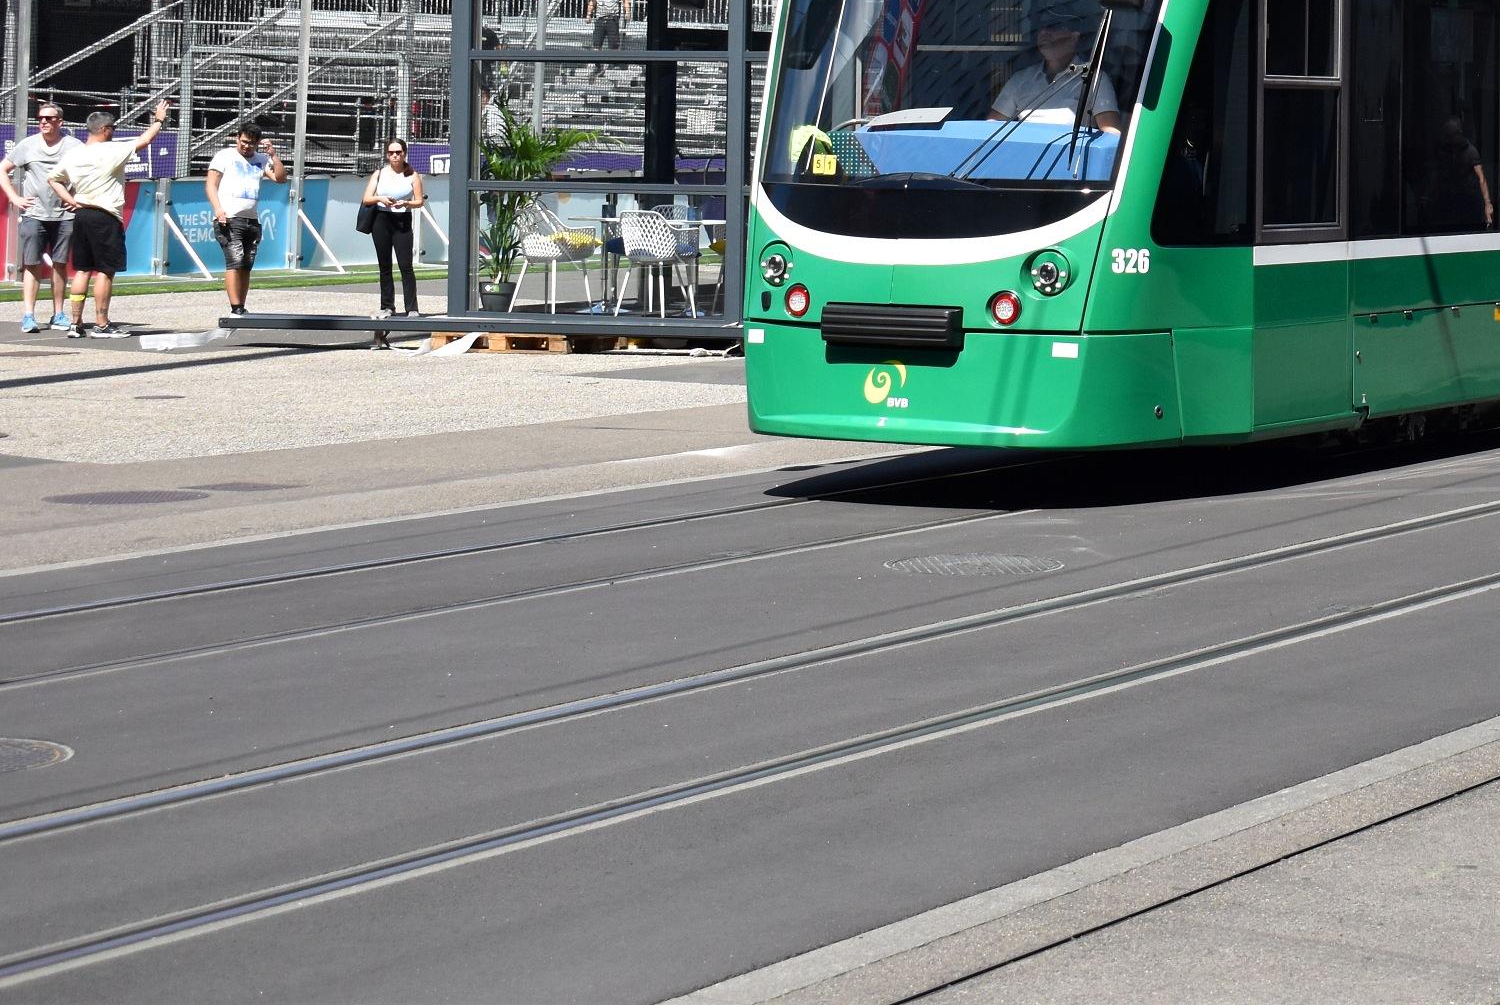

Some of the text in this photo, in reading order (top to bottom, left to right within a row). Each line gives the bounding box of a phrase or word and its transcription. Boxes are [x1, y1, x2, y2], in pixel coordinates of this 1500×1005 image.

[178, 214, 199, 226] THE
[1111, 248, 1150, 274] 326
[887, 397, 909, 408] BVB
